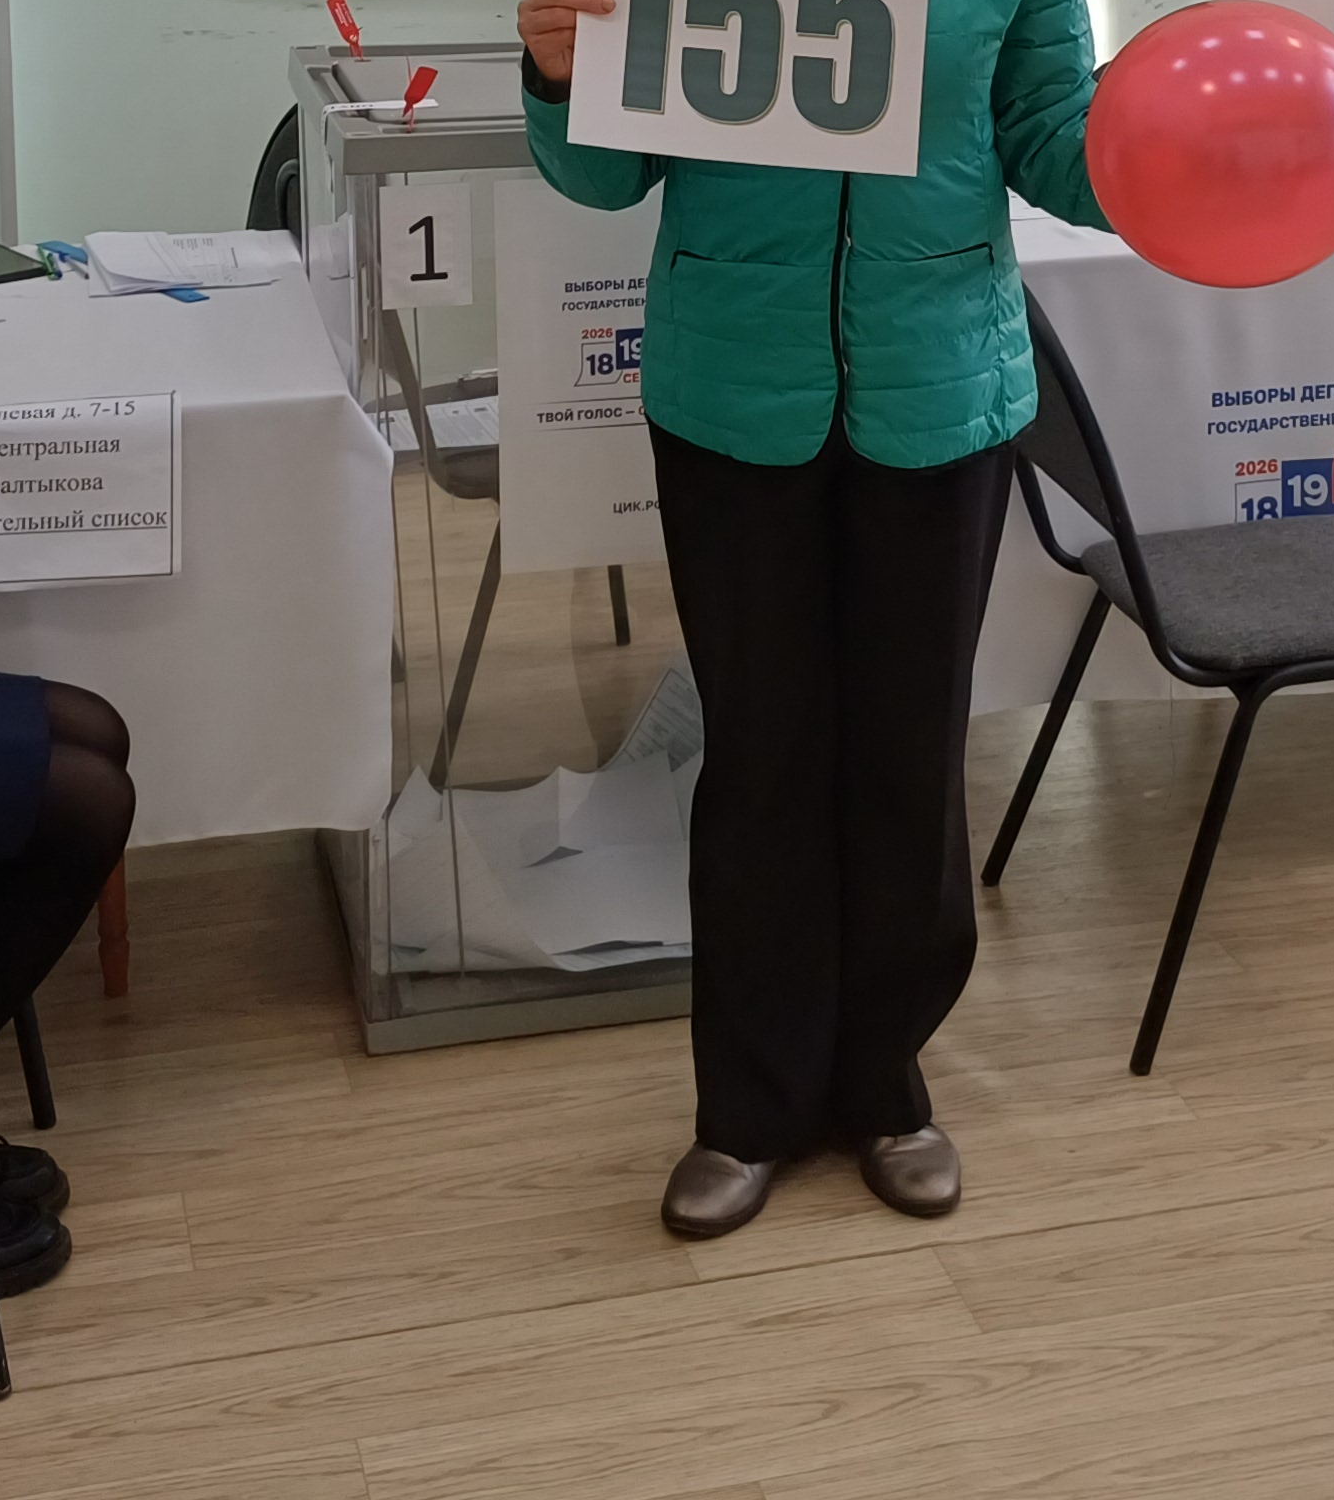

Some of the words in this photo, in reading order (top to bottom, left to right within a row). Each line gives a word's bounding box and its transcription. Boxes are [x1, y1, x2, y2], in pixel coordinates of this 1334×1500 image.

[408, 214, 449, 281] 1
[565, 279, 624, 293] ВЫБОРЫ
[581, 328, 613, 339] 2026
[586, 353, 614, 376] 18
[623, 373, 640, 383] СЕ
[1211, 386, 1295, 407] ВЫБОРЫ
[63, 405, 82, 421] д.
[90, 400, 136, 417] 7-15
[537, 409, 574, 424] ТВОЙ
[577, 406, 623, 421] ГОЛОС
[1235, 459, 1278, 476] 2026
[1287, 473, 1329, 507] 19
[91, 508, 168, 529] список
[1241, 496, 1278, 521] 18
